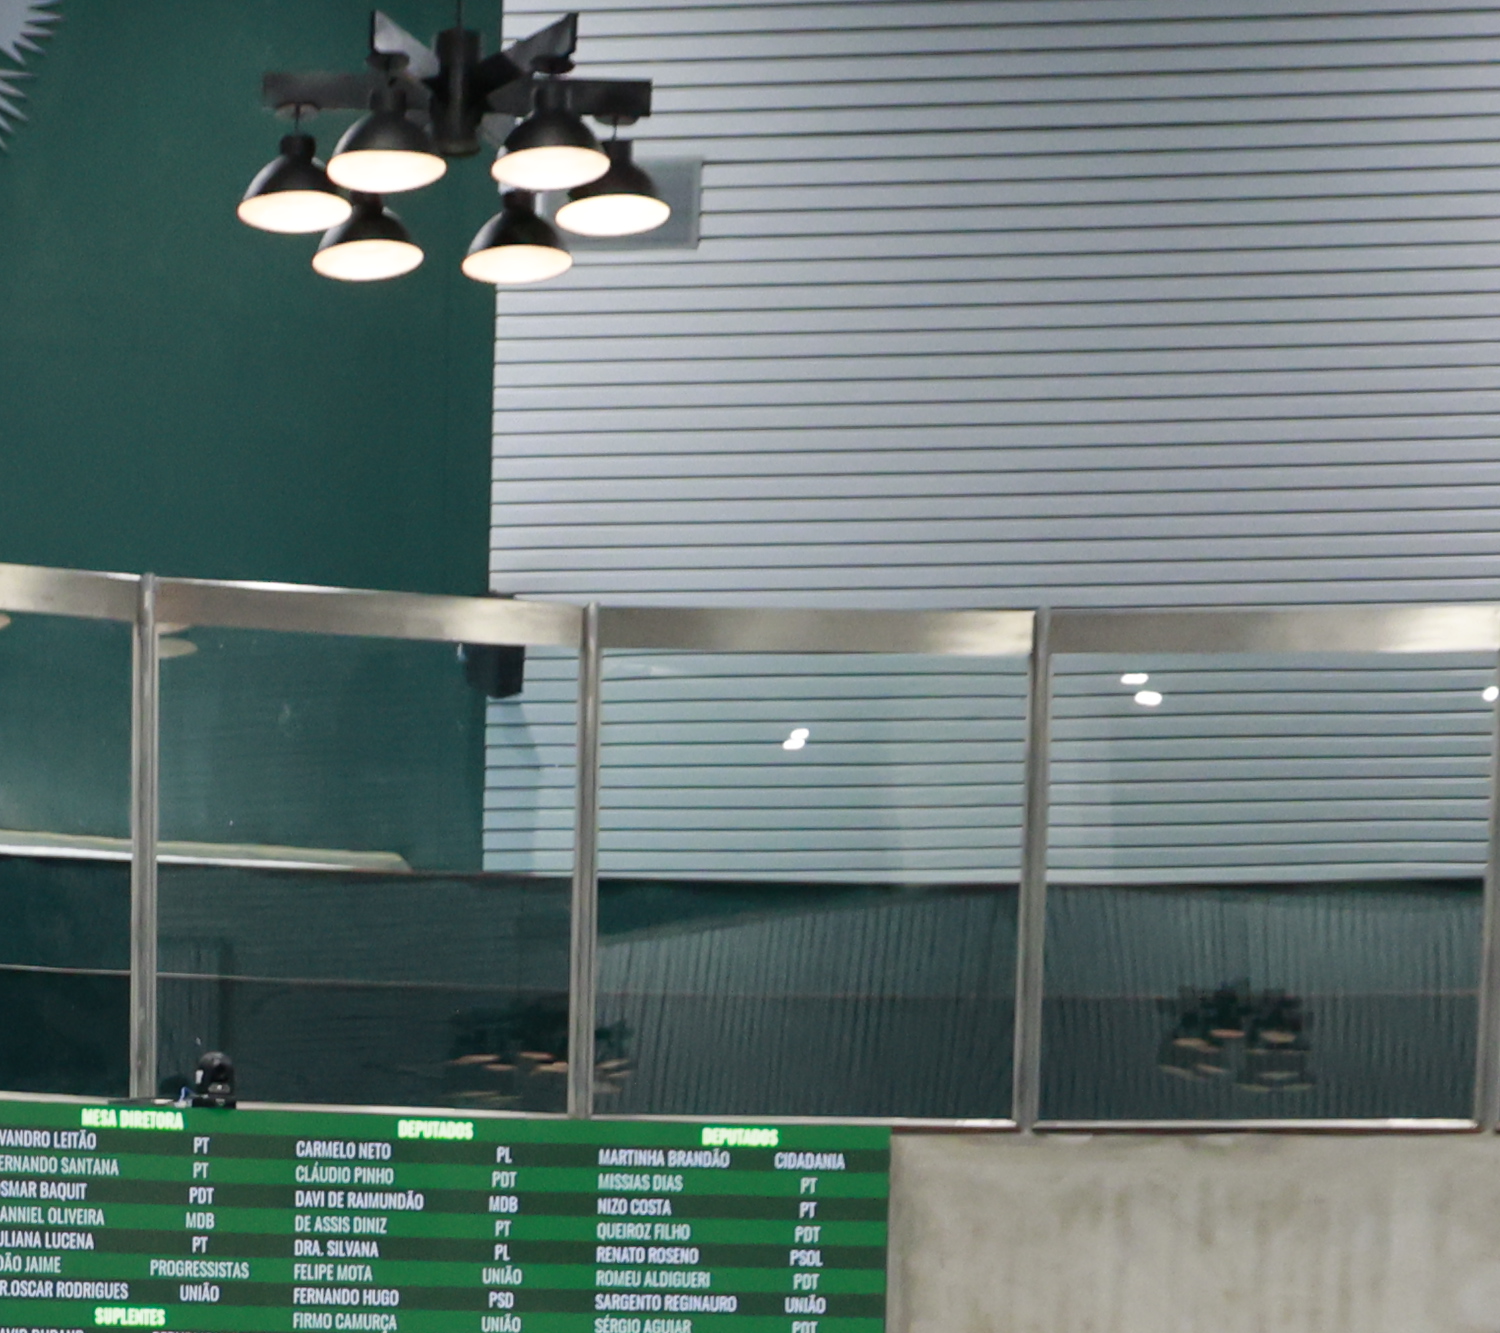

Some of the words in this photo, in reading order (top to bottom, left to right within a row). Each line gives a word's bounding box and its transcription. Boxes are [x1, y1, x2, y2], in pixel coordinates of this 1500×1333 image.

[82, 1109, 117, 1127] MESA
[120, 1110, 183, 1129] DIRETORA
[398, 1120, 473, 1139] DEPUTADOS
[702, 1128, 778, 1146] DEPUTADOS
[54, 1129, 96, 1150] LEITÃO
[194, 1137, 209, 1153] PT
[296, 1141, 355, 1158] CARMELO
[359, 1143, 391, 1159] NETO
[497, 1146, 512, 1163] PL
[599, 1149, 664, 1166] MARTINHA
[668, 1148, 729, 1168] BRANDÃO
[61, 1157, 118, 1175] SANTANA
[775, 1152, 845, 1169] CIDADANIA
[296, 1162, 350, 1183] CLÁUDIO
[355, 1167, 393, 1184] PINHO
[599, 1174, 650, 1190] MISSIAS
[653, 1175, 683, 1190] DIAS
[40, 1182, 87, 1201] BAQUIT
[189, 1187, 214, 1204] PDT
[296, 1191, 324, 1207] DAVI
[328, 1191, 344, 1208] DE
[348, 1190, 423, 1210] RAIMUNDÃO
[598, 1198, 627, 1214] NIZO
[630, 1199, 671, 1215] COSTA
[48, 1207, 104, 1225] OLIVEIRA
[186, 1212, 214, 1229] MDB
[295, 1215, 310, 1231] DE
[314, 1216, 350, 1232] ASSIS
[354, 1217, 387, 1233] DINIZ
[597, 1223, 651, 1239] QUEIROZ
[655, 1223, 690, 1239] FILHO
[45, 1232, 94, 1249] LUCENA
[295, 1239, 323, 1256] DRA.
[327, 1240, 378, 1257] SILVANA
[597, 1246, 645, 1263] RENATO
[648, 1247, 698, 1264] ROSENO
[790, 1250, 822, 1266] PSOL
[25, 1256, 60, 1273] JAIME
[151, 1260, 249, 1278] PROGRESSISTAS
[294, 1264, 333, 1280] FELIPE
[337, 1265, 372, 1280] MOTA
[596, 1270, 641, 1286] ROMEU
[644, 1271, 710, 1287] ALDIGUERI
[57, 1281, 128, 1299] RODRIGUES
[180, 1282, 219, 1302] UNIÃO
[294, 1288, 359, 1305] FERNANDO
[363, 1289, 399, 1306] HUGO
[489, 1292, 513, 1308] PSD
[595, 1294, 661, 1310] SARGENTO
[664, 1295, 737, 1312] REGINAURO
[95, 1307, 165, 1326] SUPLENTES
[293, 1313, 332, 1329] FIRMO
[336, 1313, 396, 1333] CAMURÇA
